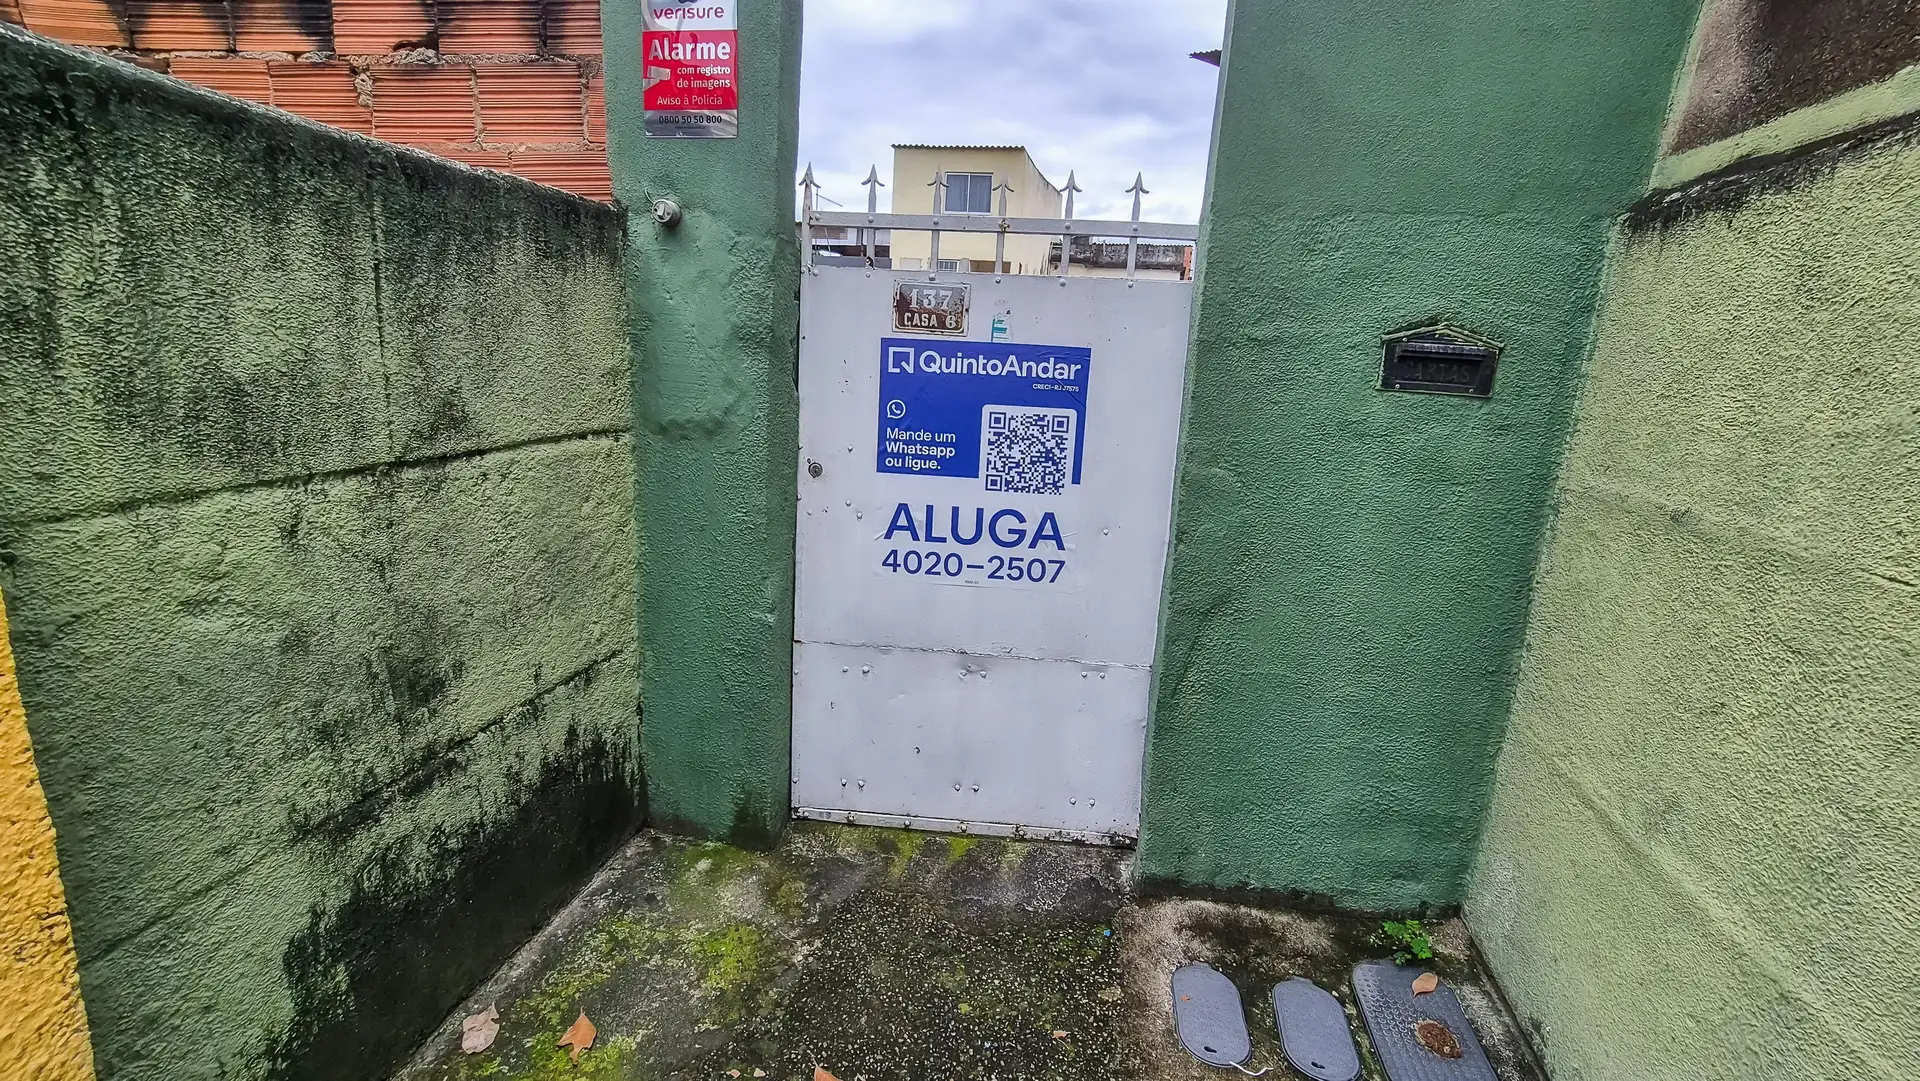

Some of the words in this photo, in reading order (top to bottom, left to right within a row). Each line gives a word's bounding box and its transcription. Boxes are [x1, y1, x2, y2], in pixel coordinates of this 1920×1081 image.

[653, 6, 725, 20] verisure
[648, 37, 731, 61] Alarme
[677, 66, 695, 75] com
[696, 64, 731, 76] registro
[677, 78, 689, 88] de
[690, 77, 731, 90] imagens
[657, 95, 681, 105] Aviso
[683, 94, 689, 105] à
[691, 94, 723, 105] Polícia
[658, 115, 680, 124] 0800
[681, 115, 692, 124] 50
[693, 115, 704, 124] 50
[706, 115, 722, 124] 800
[909, 288, 953, 310] 137
[904, 312, 938, 328] CASA
[945, 314, 957, 329] 6
[919, 350, 1082, 380] QuintoAndar
[1032, 383, 1062, 391] CRECI-RJ
[886, 427, 932, 442] Mande
[935, 432, 956, 443] um
[886, 441, 956, 459] Whatsapp
[885, 457, 902, 467] ou
[905, 456, 941, 471] ligue.
[883, 502, 1066, 551] ALUGA
[881, 549, 1066, 583] 4020-2507
